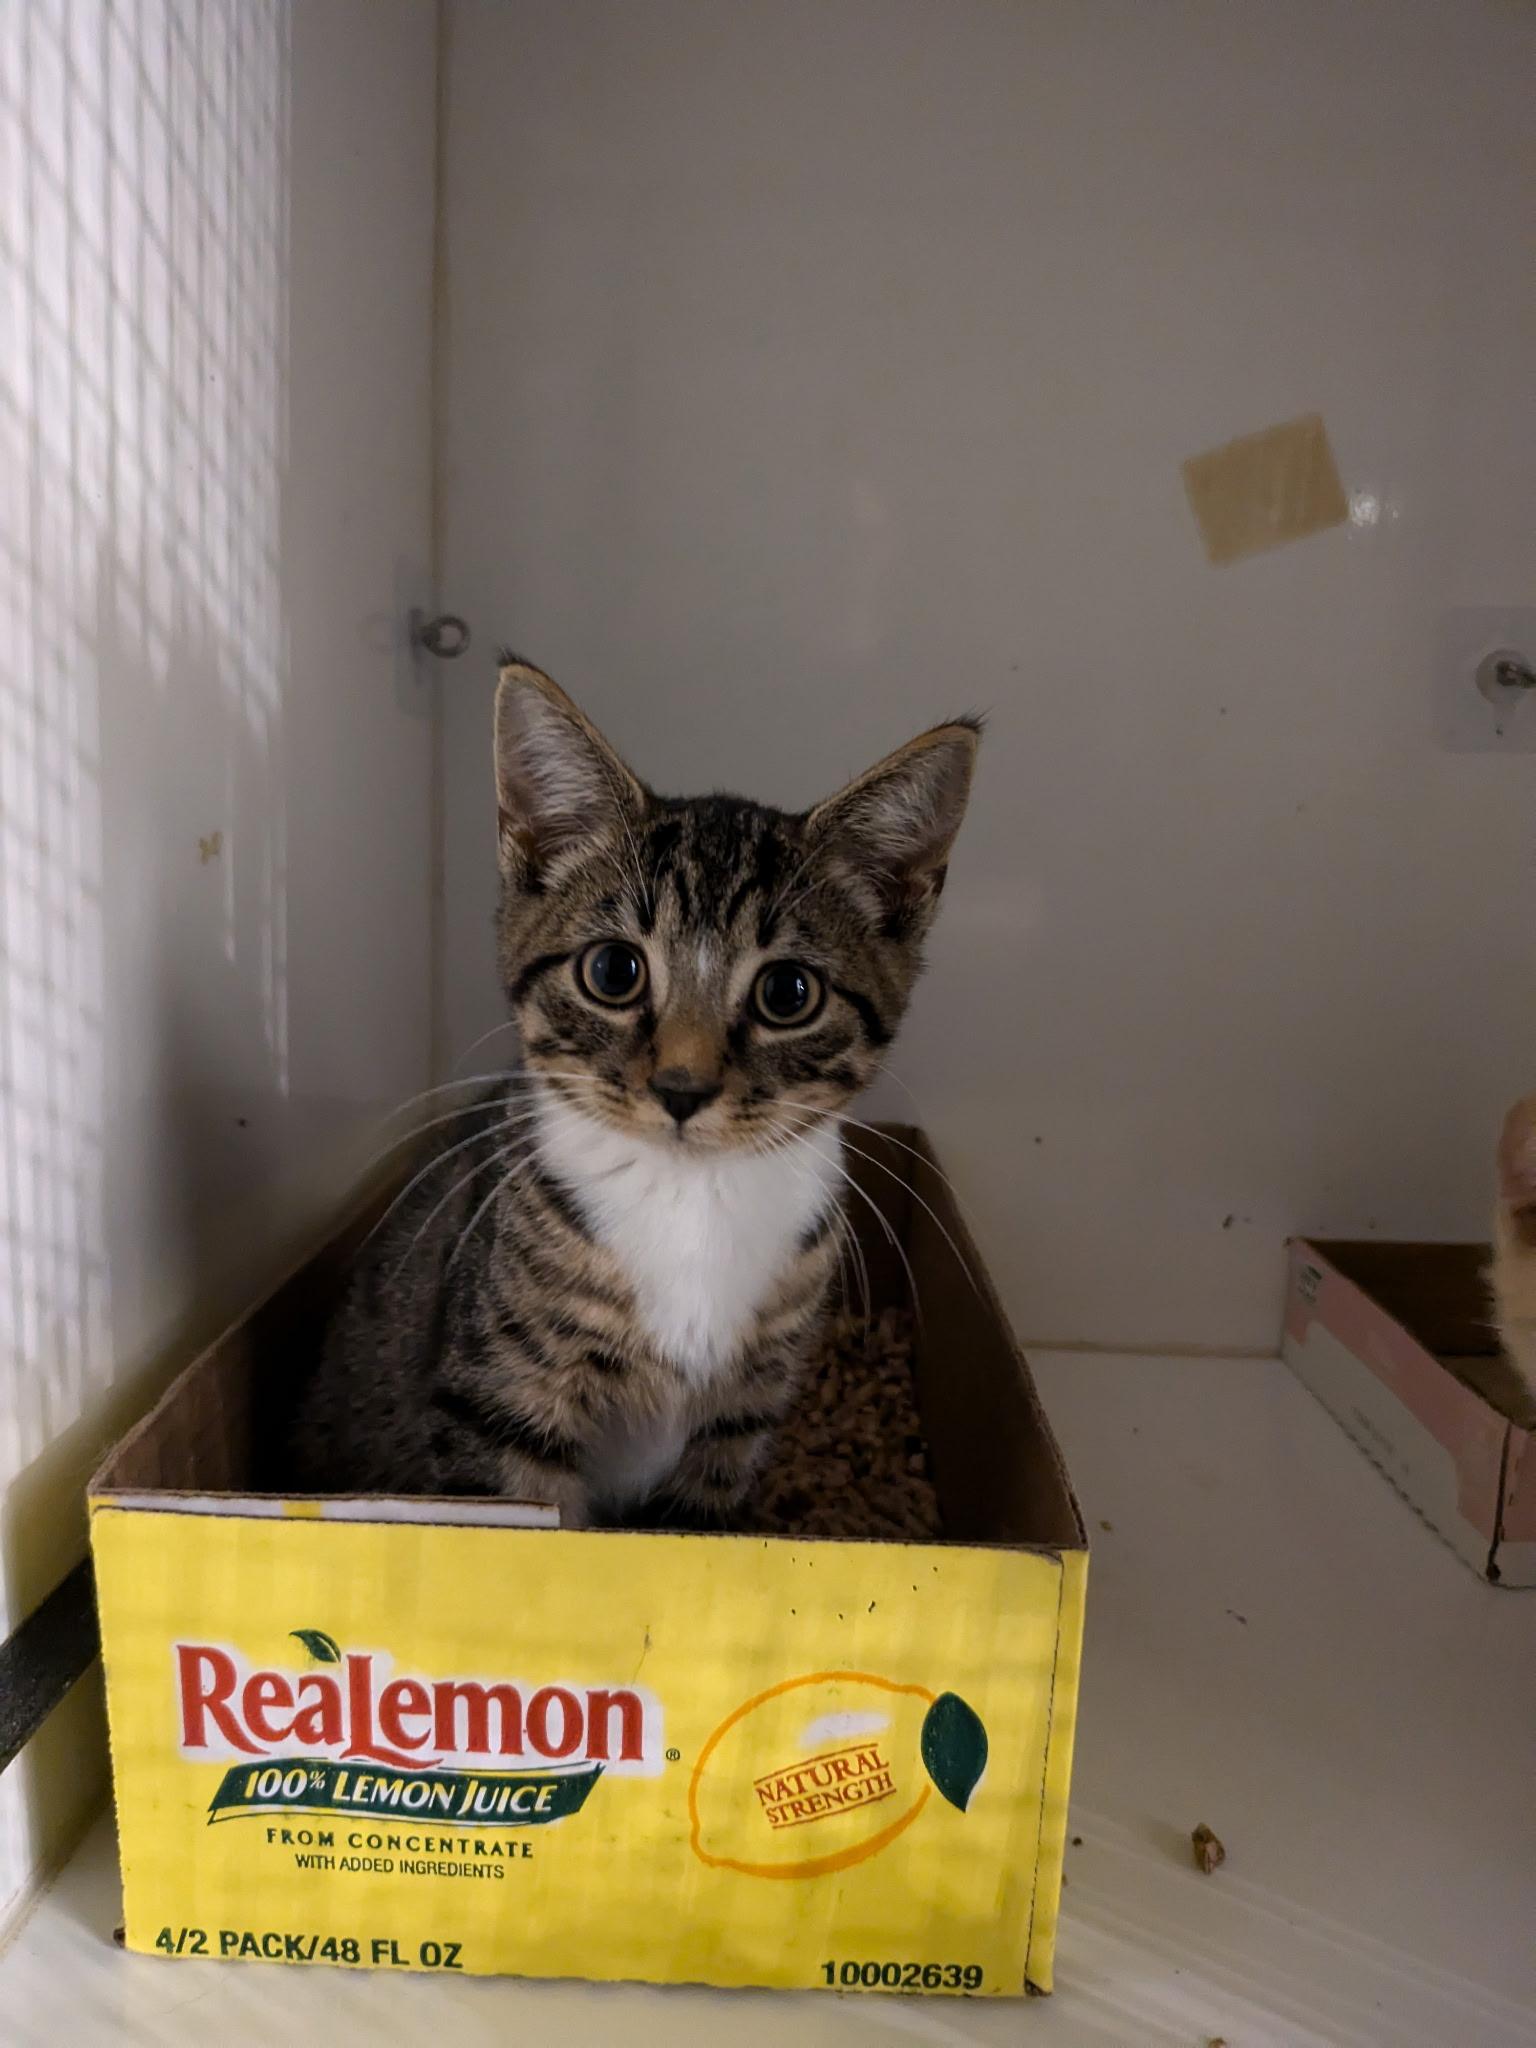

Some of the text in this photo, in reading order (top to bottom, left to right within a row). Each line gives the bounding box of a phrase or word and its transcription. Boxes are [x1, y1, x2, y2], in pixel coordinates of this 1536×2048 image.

[177, 1643, 644, 1769] ReaLemon
[244, 1767, 558, 1815] 100% LEMON JUICE
[755, 1748, 890, 1807] NATURAL
[765, 1771, 895, 1826] STRENGTH
[267, 1828, 534, 1858] FROM CONCENTRATE
[295, 1853, 505, 1880] WITH ADDED INGREDIENTS
[155, 1928, 464, 1969] 4/2 PACK/48 FL OZ
[820, 1961, 984, 1990] 10002639
